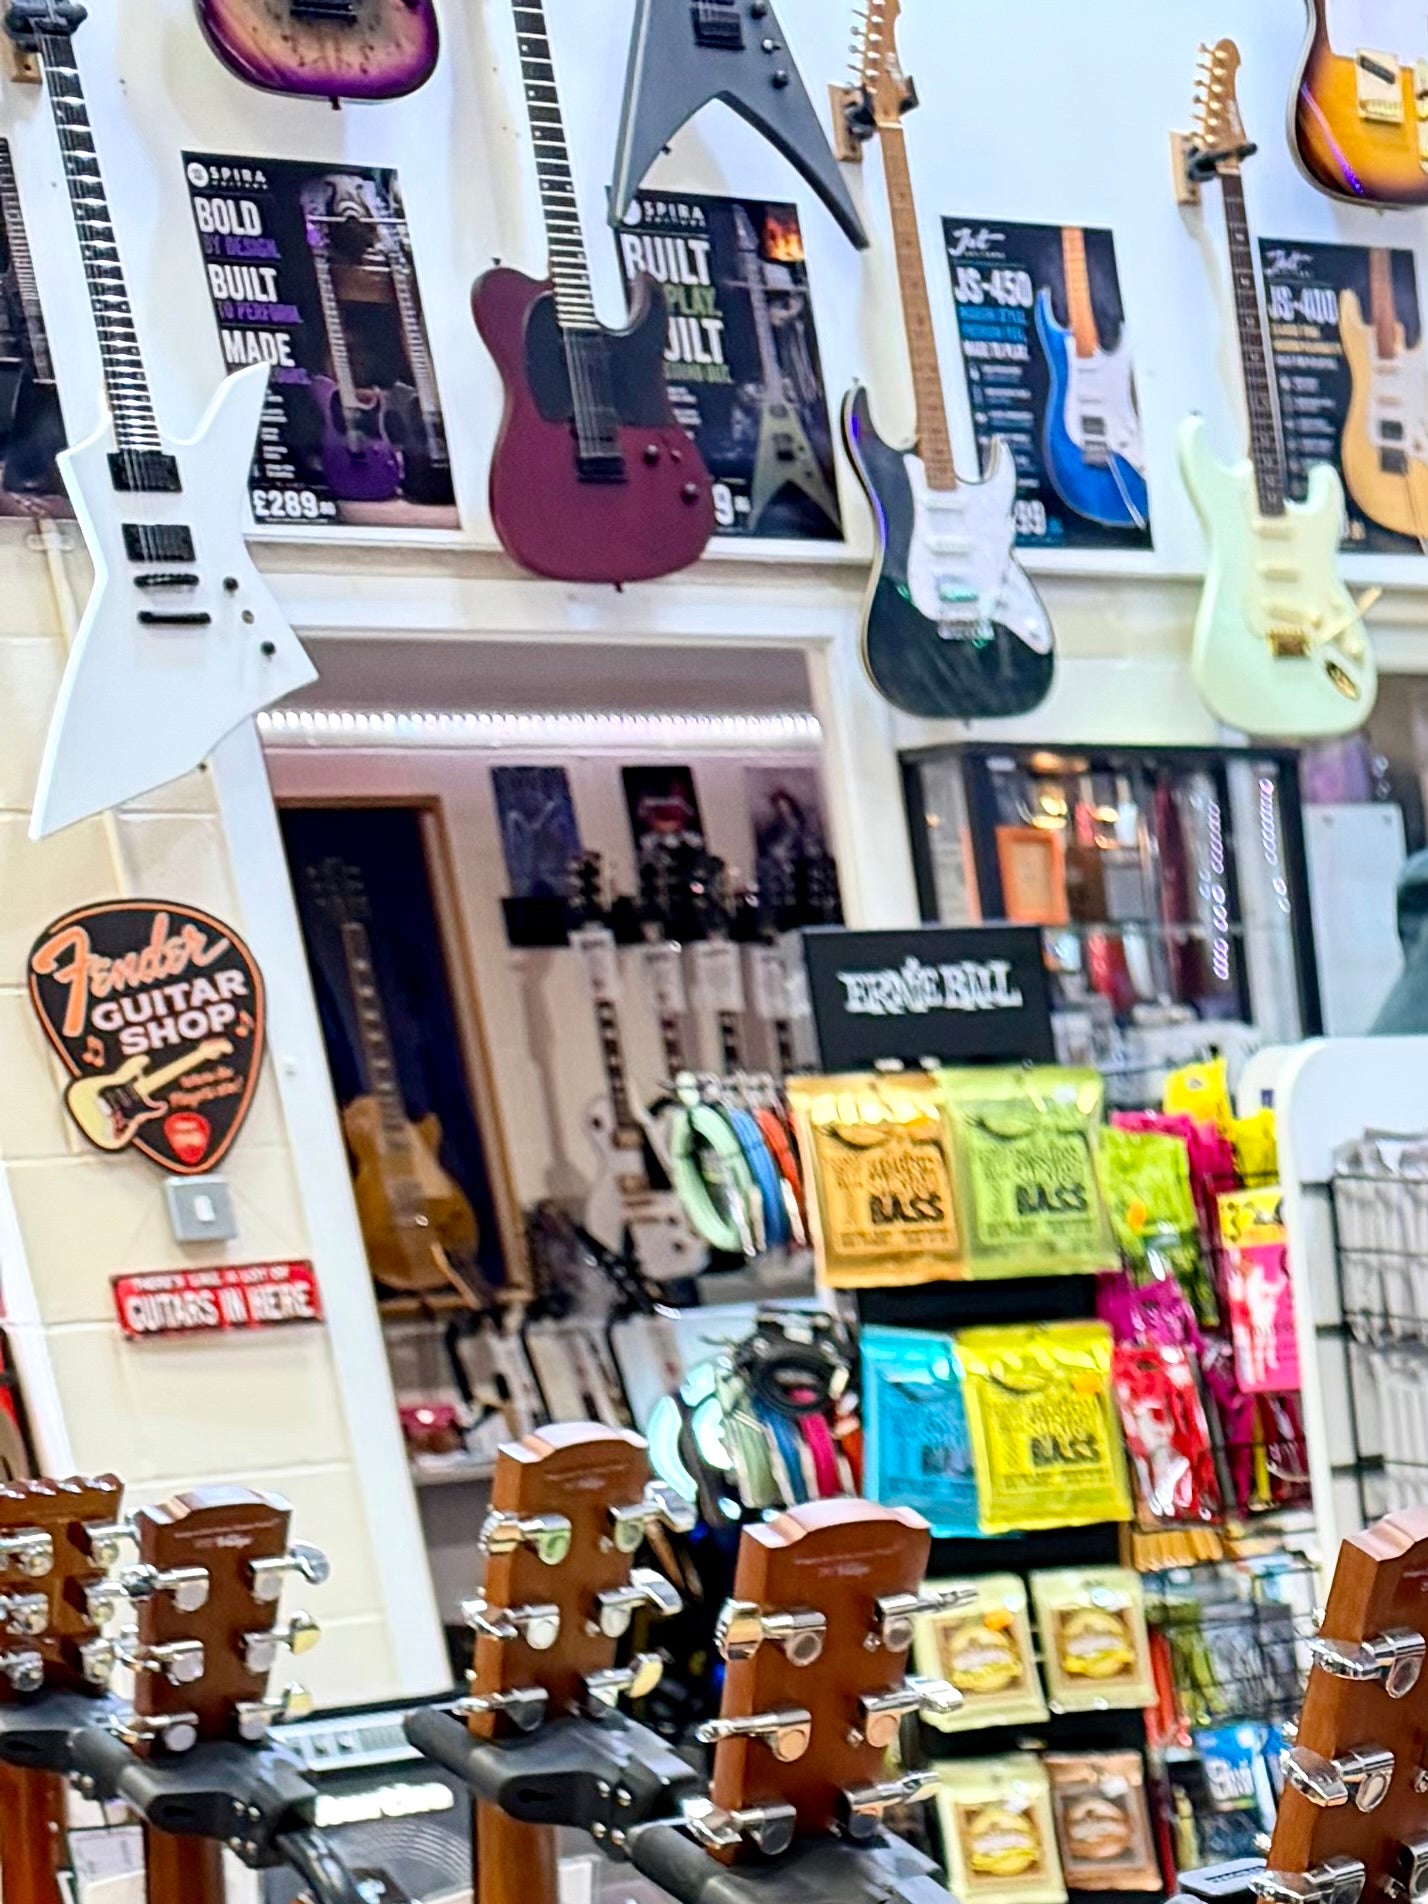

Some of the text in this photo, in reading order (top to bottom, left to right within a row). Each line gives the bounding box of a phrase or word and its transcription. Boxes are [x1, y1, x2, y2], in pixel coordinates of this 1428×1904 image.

[207, 165, 268, 183] SPIRA
[193, 196, 262, 236] BOLD
[643, 201, 706, 219] SPIRA
[207, 263, 278, 302] BUILT
[221, 329, 296, 367] MADE
[32, 911, 231, 1038] Fender
[838, 954, 1024, 1017] ERNIE BALL
[91, 969, 249, 1031] GUITAR
[119, 1002, 236, 1056] SHOP
[869, 1193, 945, 1225] BASS
[1015, 1182, 1089, 1215] BASS
[1030, 1433, 1101, 1467] BASS
